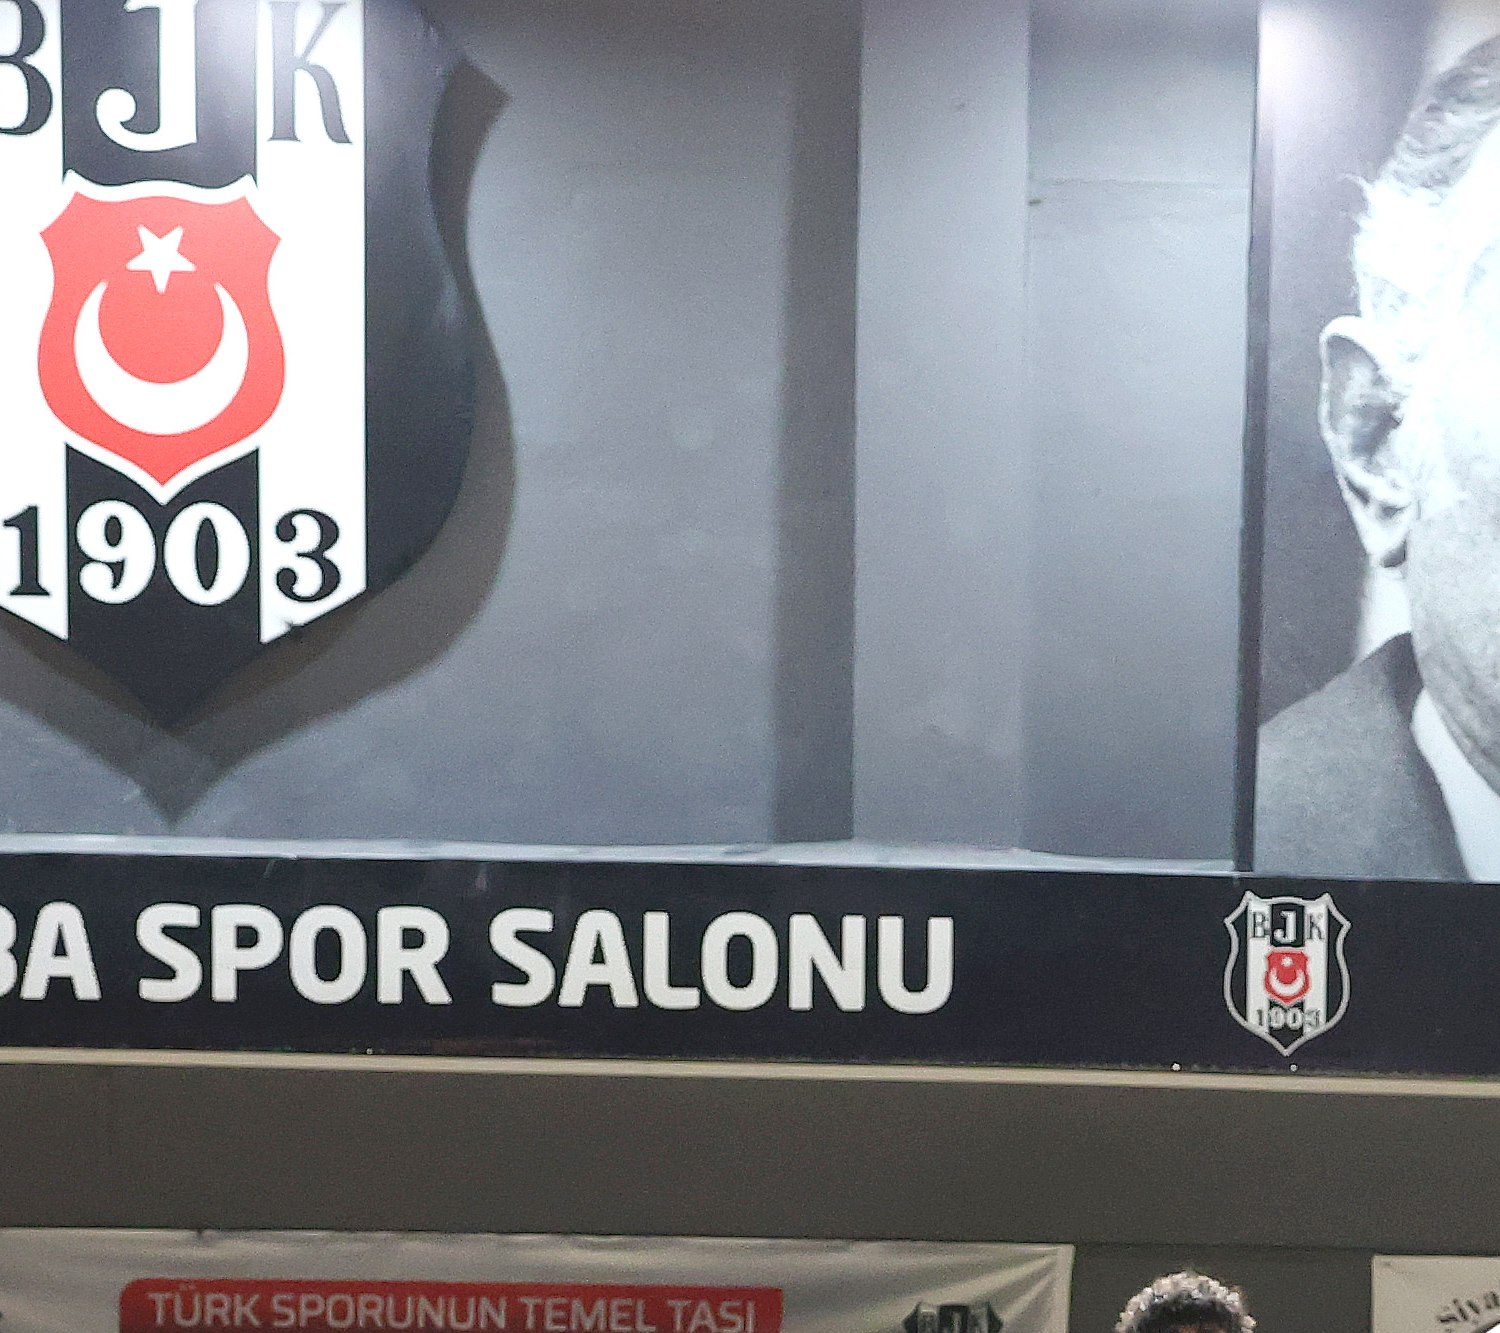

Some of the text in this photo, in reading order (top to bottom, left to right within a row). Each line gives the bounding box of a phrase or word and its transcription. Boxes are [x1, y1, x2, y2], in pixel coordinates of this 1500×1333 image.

[2, 499, 342, 607] 1903
[134, 902, 453, 1005] SPOR
[489, 907, 956, 1014] SALONU
[148, 1284, 261, 1328] TÜRK
[272, 1291, 507, 1332] SPORUNUN
